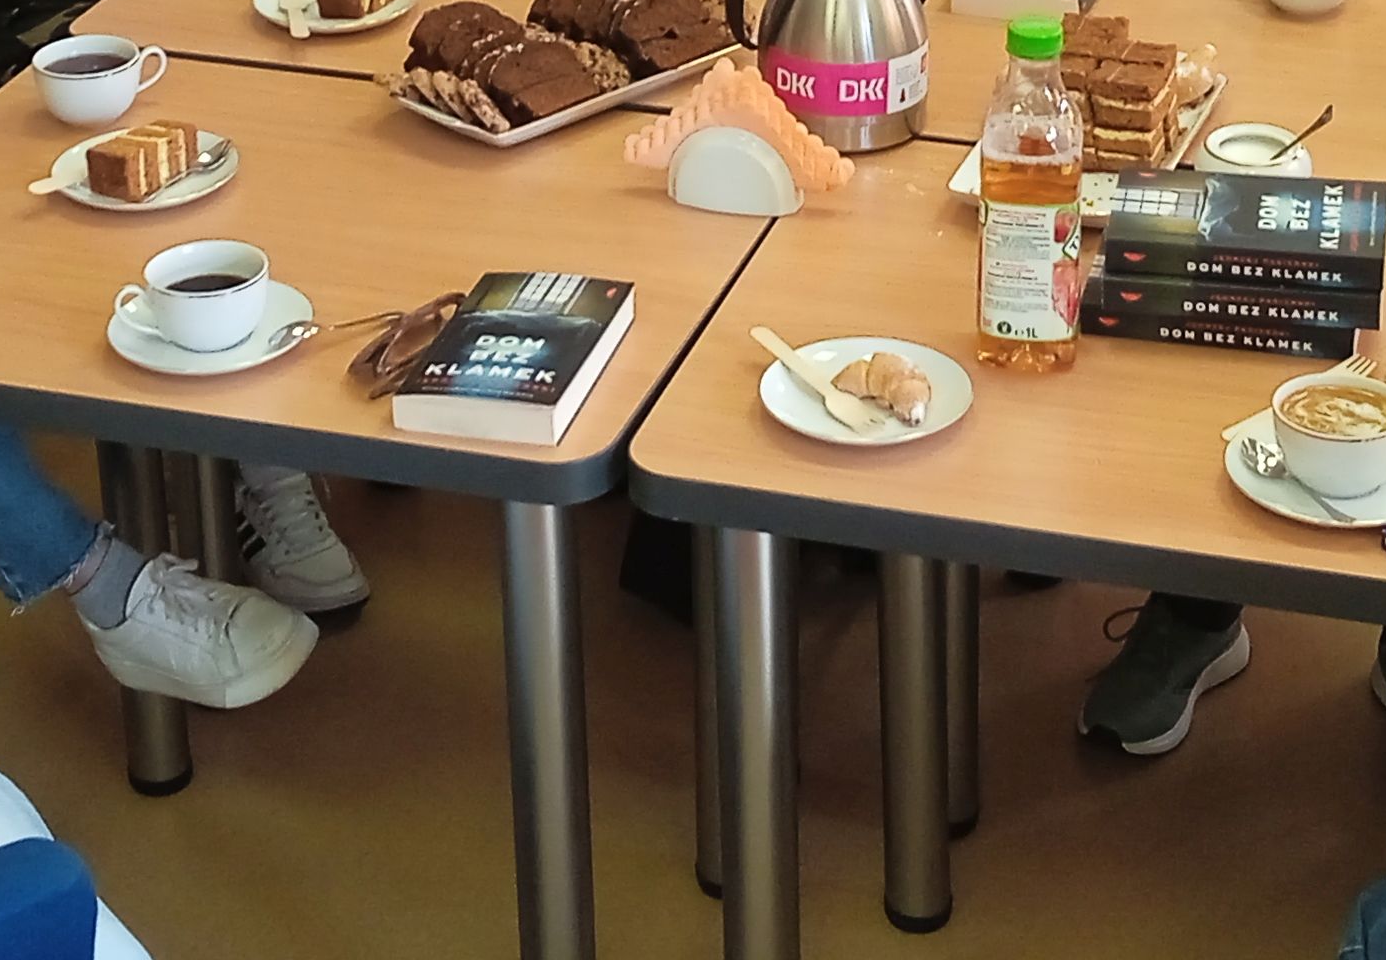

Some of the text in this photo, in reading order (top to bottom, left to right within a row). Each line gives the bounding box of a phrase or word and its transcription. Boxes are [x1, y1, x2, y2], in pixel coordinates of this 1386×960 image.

[1257, 194, 1280, 231] DOM
[1290, 199, 1312, 231] BEZ
[1319, 184, 1344, 250] KLAMEK
[1186, 261, 1223, 274] DOM
[1231, 265, 1264, 277] BEZ
[1272, 268, 1343, 283] KLAMEK
[1183, 301, 1340, 322] DOM BEZ KLAMEK
[475, 334, 546, 351] DOM
[1160, 327, 1195, 340] DOM
[1203, 331, 1236, 344] BEZ
[1244, 336, 1313, 352] KLAMEK
[468, 349, 539, 364] BEZ
[424, 362, 556, 384] KLAMEK
